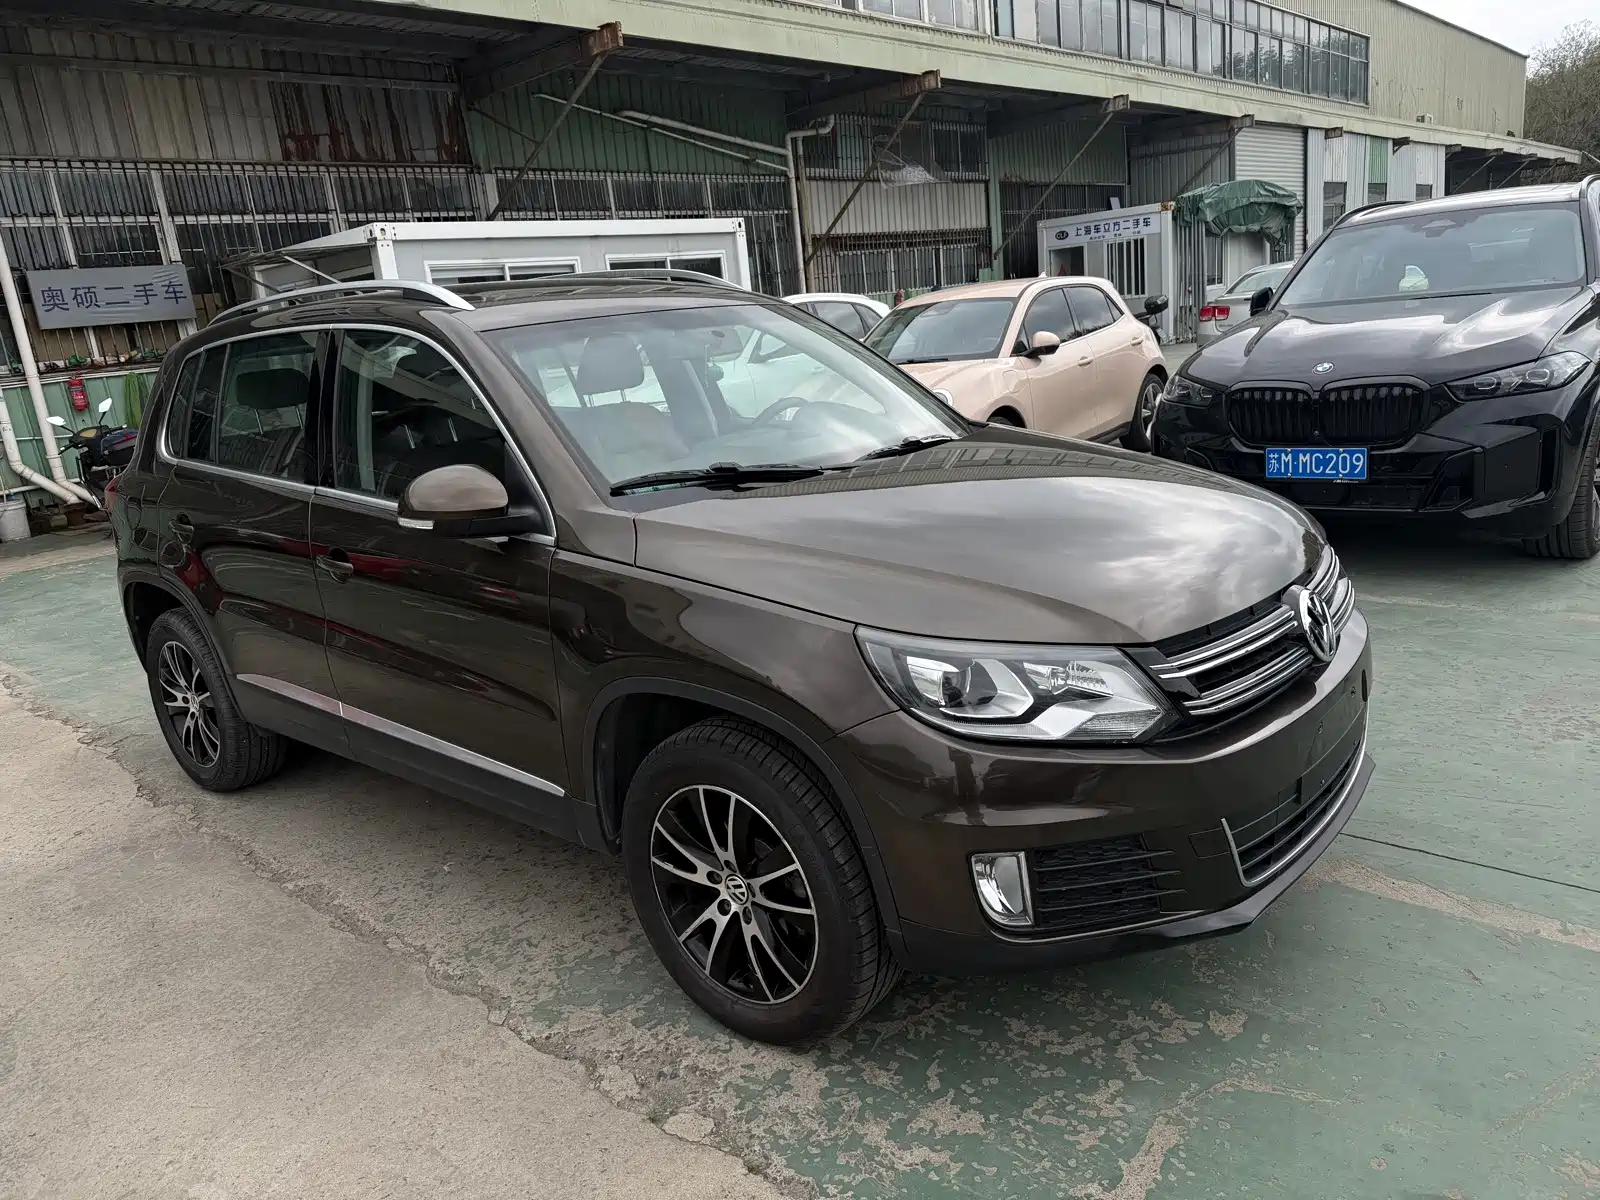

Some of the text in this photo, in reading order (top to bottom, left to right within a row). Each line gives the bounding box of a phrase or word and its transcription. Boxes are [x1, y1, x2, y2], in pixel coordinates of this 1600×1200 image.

[1074, 217, 1151, 237] 上海车立方二手车
[41, 280, 187, 312] 奥硕二手车
